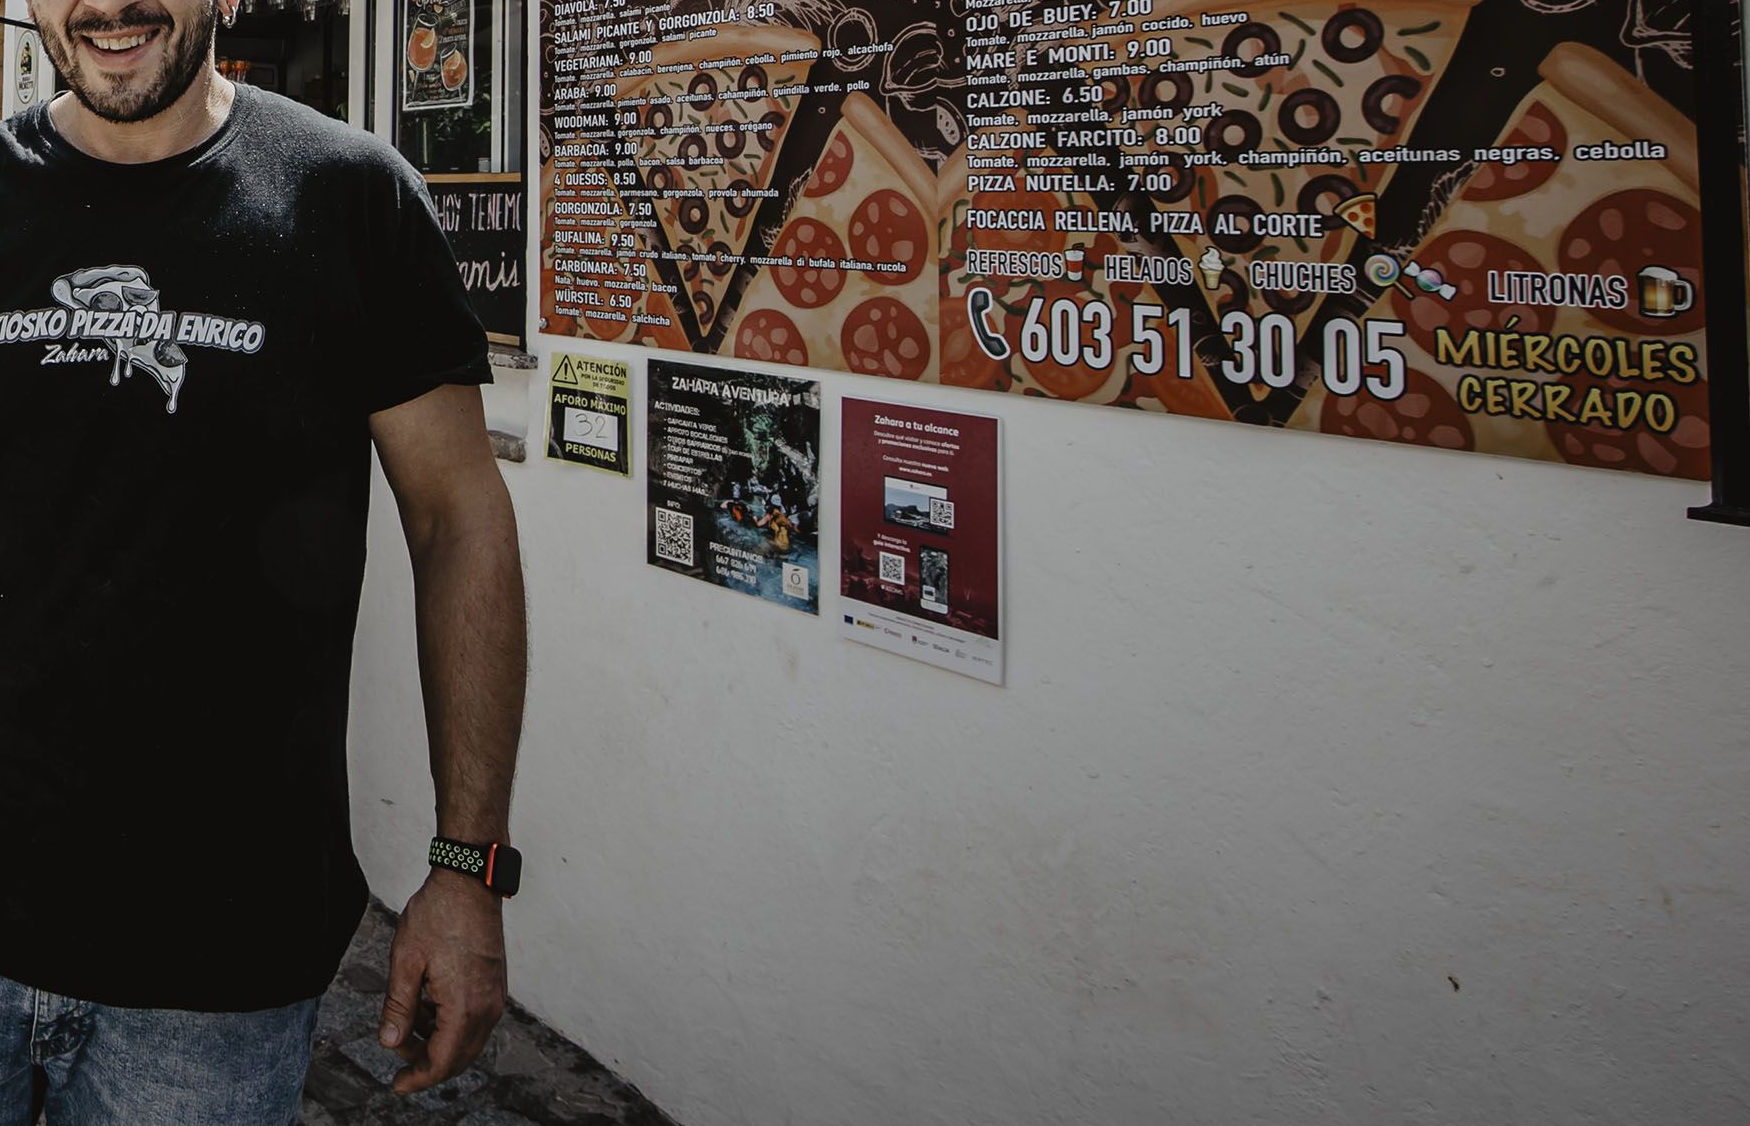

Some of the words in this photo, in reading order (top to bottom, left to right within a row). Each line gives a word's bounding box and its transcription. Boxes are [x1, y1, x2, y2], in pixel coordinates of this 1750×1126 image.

[555, 0, 598, 16] DIAVOLA:
[554, 28, 591, 45] SALAMI
[597, 21, 639, 39] PICANTE
[646, 20, 653, 32] Y
[659, 9, 739, 30] GORGONZOLA:
[747, 2, 774, 19] 8.50
[966, 52, 1015, 71] MARE
[1027, 50, 1037, 66] E
[1049, 44, 1115, 64] MONTI:
[1127, 38, 1171, 58] 9.00
[555, 143, 609, 157] BARBACOA:
[615, 143, 637, 155] 9.00
[967, 133, 1046, 151] CALZONE
[1057, 130, 1143, 147] FARCITO:
[1155, 127, 1201, 145] 8.00
[1119, 152, 1169, 169] jamón
[1359, 146, 1460, 163] aceitunas
[1575, 141, 1666, 160] cebolla
[555, 173, 560, 185] 4
[566, 173, 608, 185] QUESOS:
[613, 173, 636, 185] 8.50
[967, 175, 1015, 192] PIZZA
[1026, 175, 1115, 191] NUTELLA:
[1128, 174, 1172, 191] 7.00
[967, 210, 1046, 230] FOCACCIA
[1055, 211, 1138, 233] RELLENA,
[1150, 212, 1203, 234] PIZZA
[1215, 214, 1241, 235] AL
[1253, 214, 1323, 238] CORTE
[555, 259, 618, 275] CARBONARA:
[624, 264, 646, 277] 7.50
[968, 250, 1062, 276] REFRESCOS
[1105, 255, 1193, 284] HELADOS
[1251, 261, 1356, 293] CHUCHES
[1490, 270, 1627, 308] LITRONAS
[555, 289, 604, 306] WÜRSTEL:
[609, 295, 632, 308] 6.50
[70, 310, 136, 338] PIZZA
[138, 313, 175, 340] DA
[177, 315, 264, 352] ENRICO
[41, 344, 110, 366] Zahara
[1020, 298, 1112, 369] 603
[1132, 304, 1192, 379] 51
[1221, 310, 1295, 388] 30
[1322, 317, 1407, 400] 05
[1436, 316, 1699, 383] MIÉRCOLES
[577, 360, 627, 378] ATENCIÓN
[554, 394, 588, 407] AFORO
[672, 377, 719, 396] ZAHARA
[722, 384, 791, 407] AVENTURA
[1459, 376, 1675, 432] CERRADO
[574, 413, 608, 439] 32
[874, 414, 904, 427] Zahara
[905, 421, 911, 429] a
[913, 421, 922, 430] tu
[924, 423, 959, 436] alcance
[566, 443, 616, 462] PERSONAS
